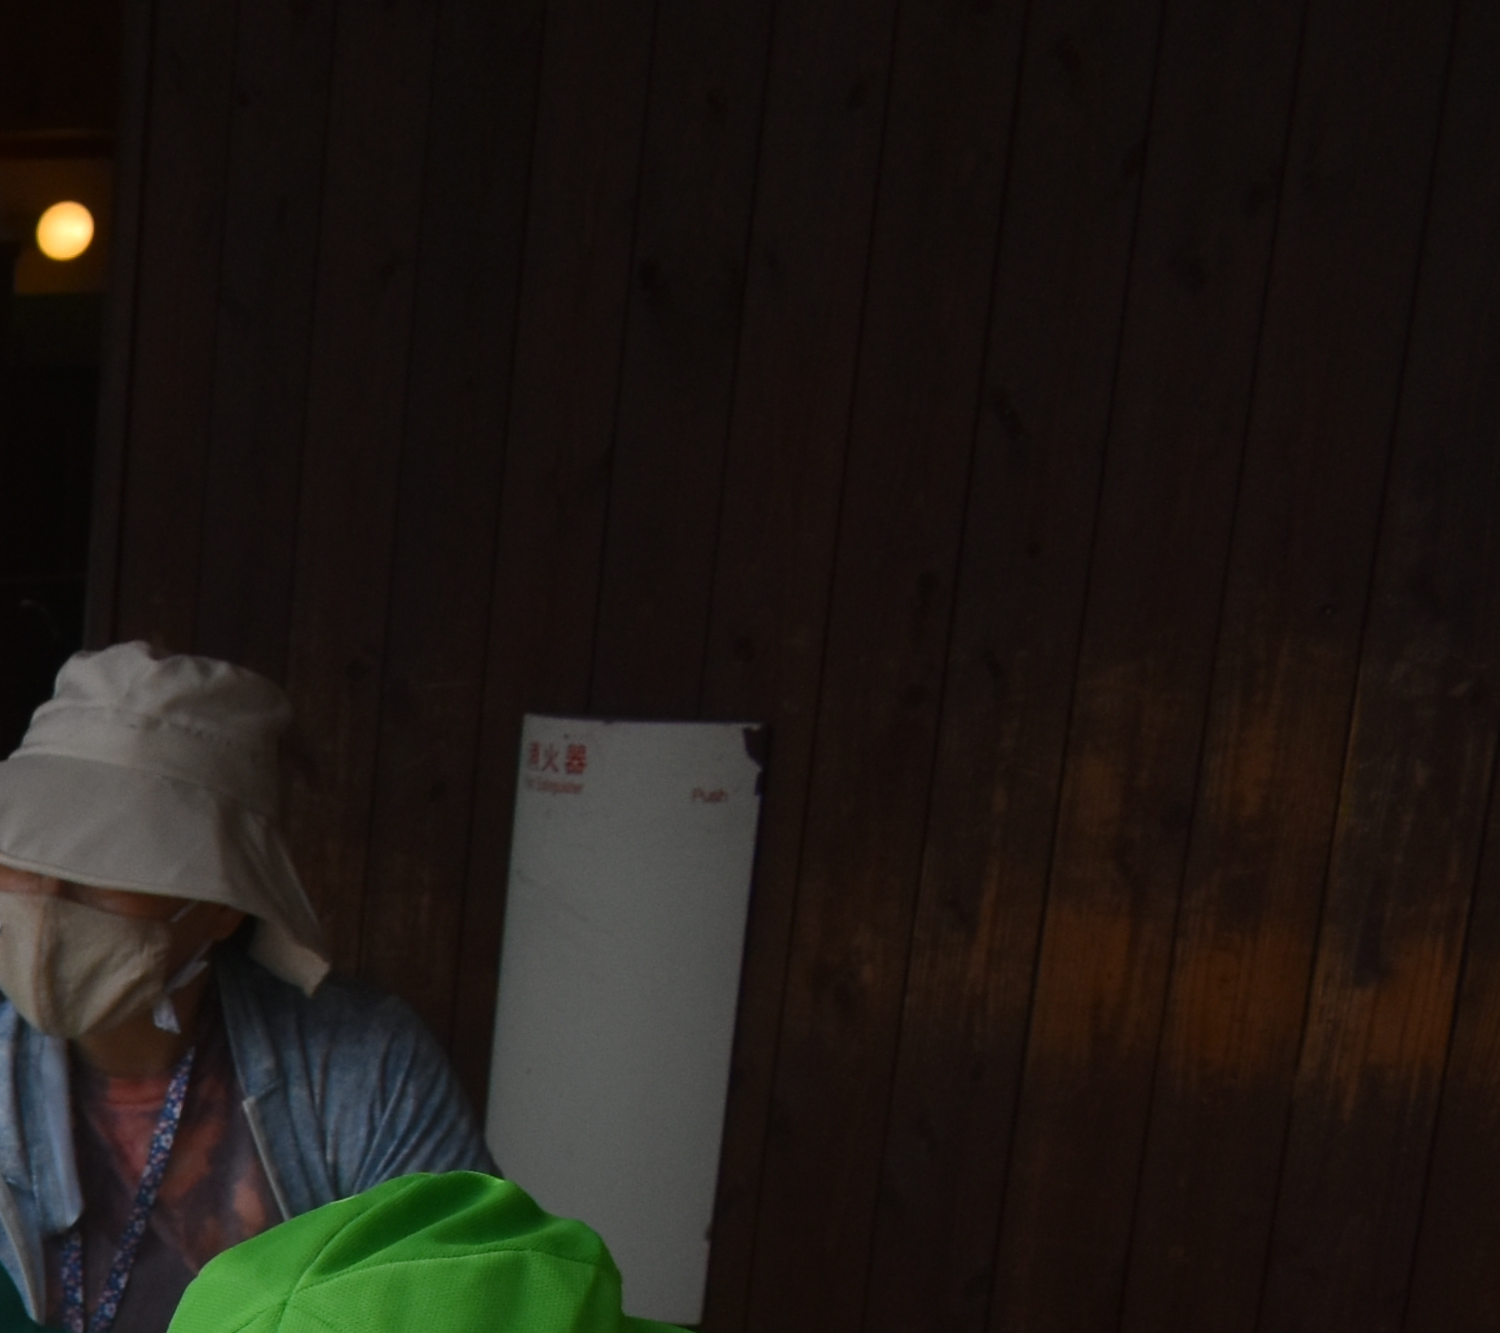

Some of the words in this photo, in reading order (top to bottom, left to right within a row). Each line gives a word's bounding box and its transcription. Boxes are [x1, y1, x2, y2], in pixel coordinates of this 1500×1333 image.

[527, 741, 588, 774] 消火器
[690, 787, 729, 804] Push
